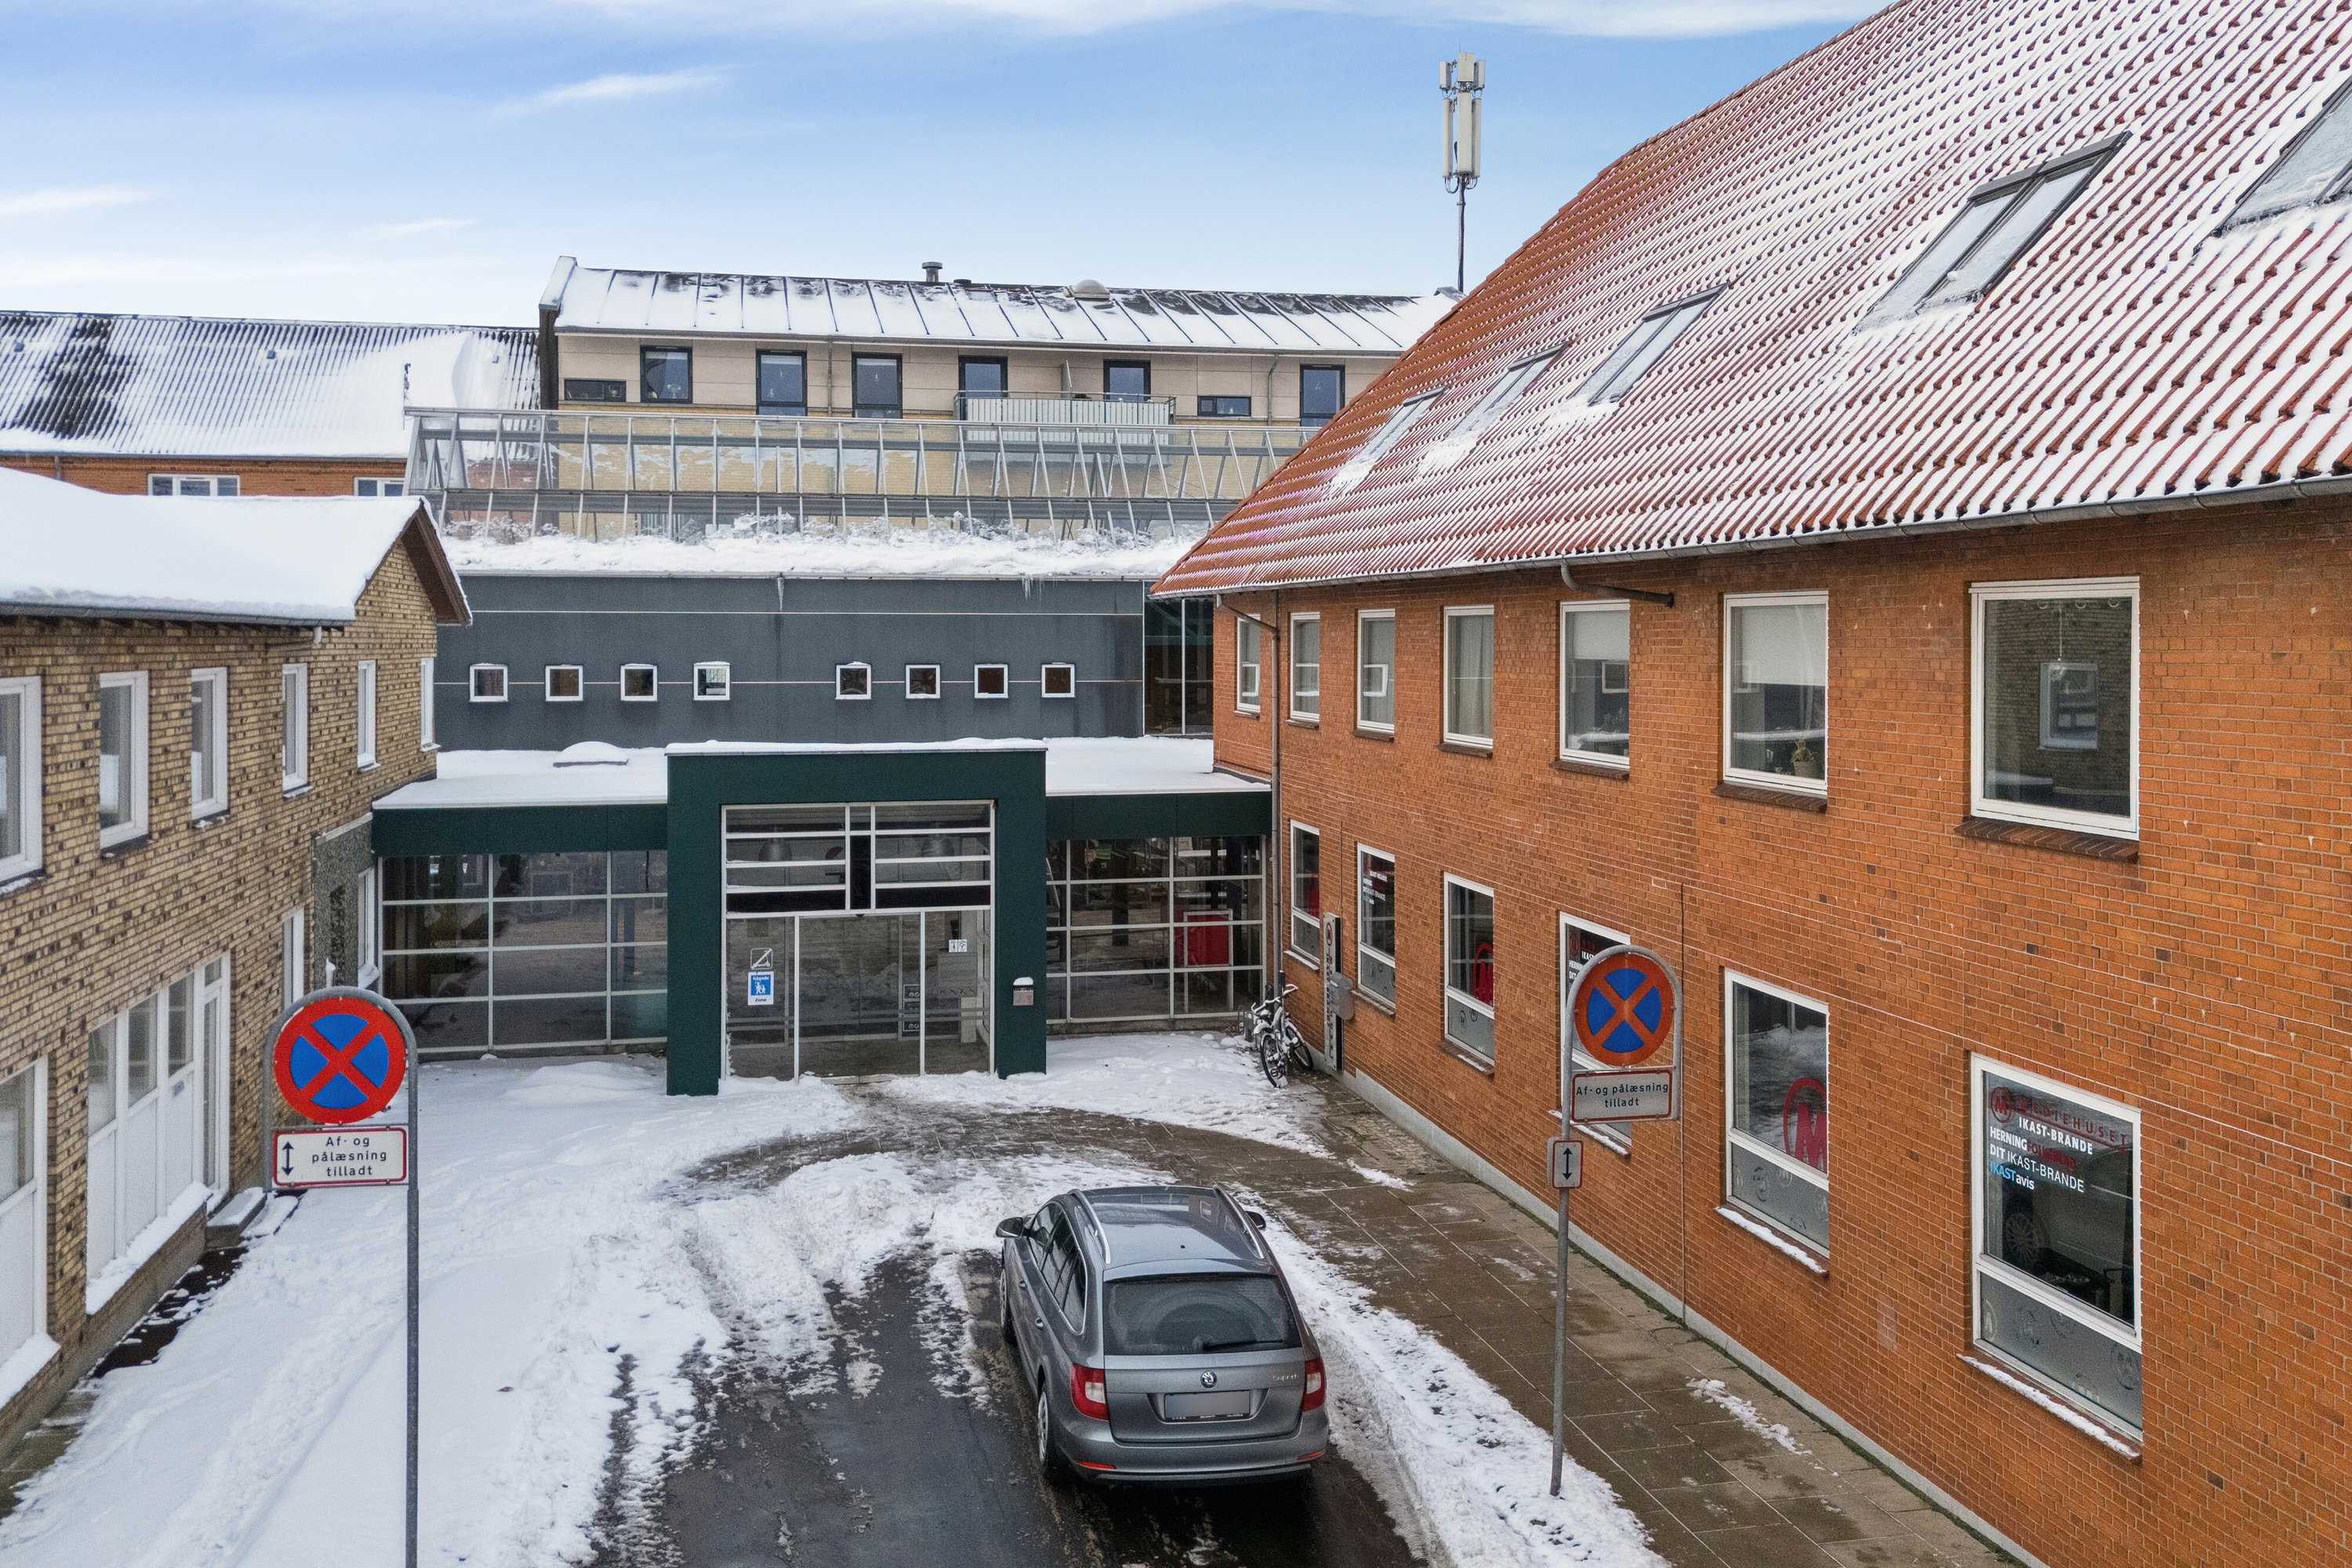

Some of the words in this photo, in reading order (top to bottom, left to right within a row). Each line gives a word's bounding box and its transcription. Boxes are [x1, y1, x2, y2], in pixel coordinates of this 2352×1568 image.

[1576, 1086, 1592, 1095] Af-
[1595, 1087, 1608, 1095] og
[1612, 1083, 1668, 1094] pålæsning
[1605, 1098, 1639, 1107] tilladt
[2019, 1098, 2126, 1146] MEDIEHUSET
[353, 1138, 369, 1147] og
[2019, 1116, 2094, 1156] IKAST-BRANDE
[312, 1150, 387, 1163] pålæsning
[326, 1166, 372, 1176] tilladt
[1990, 1143, 2006, 1160] DIT
[2007, 1150, 2085, 1193] IKAST-BRANDE
[1990, 1161, 2035, 1190] IKASTavis
